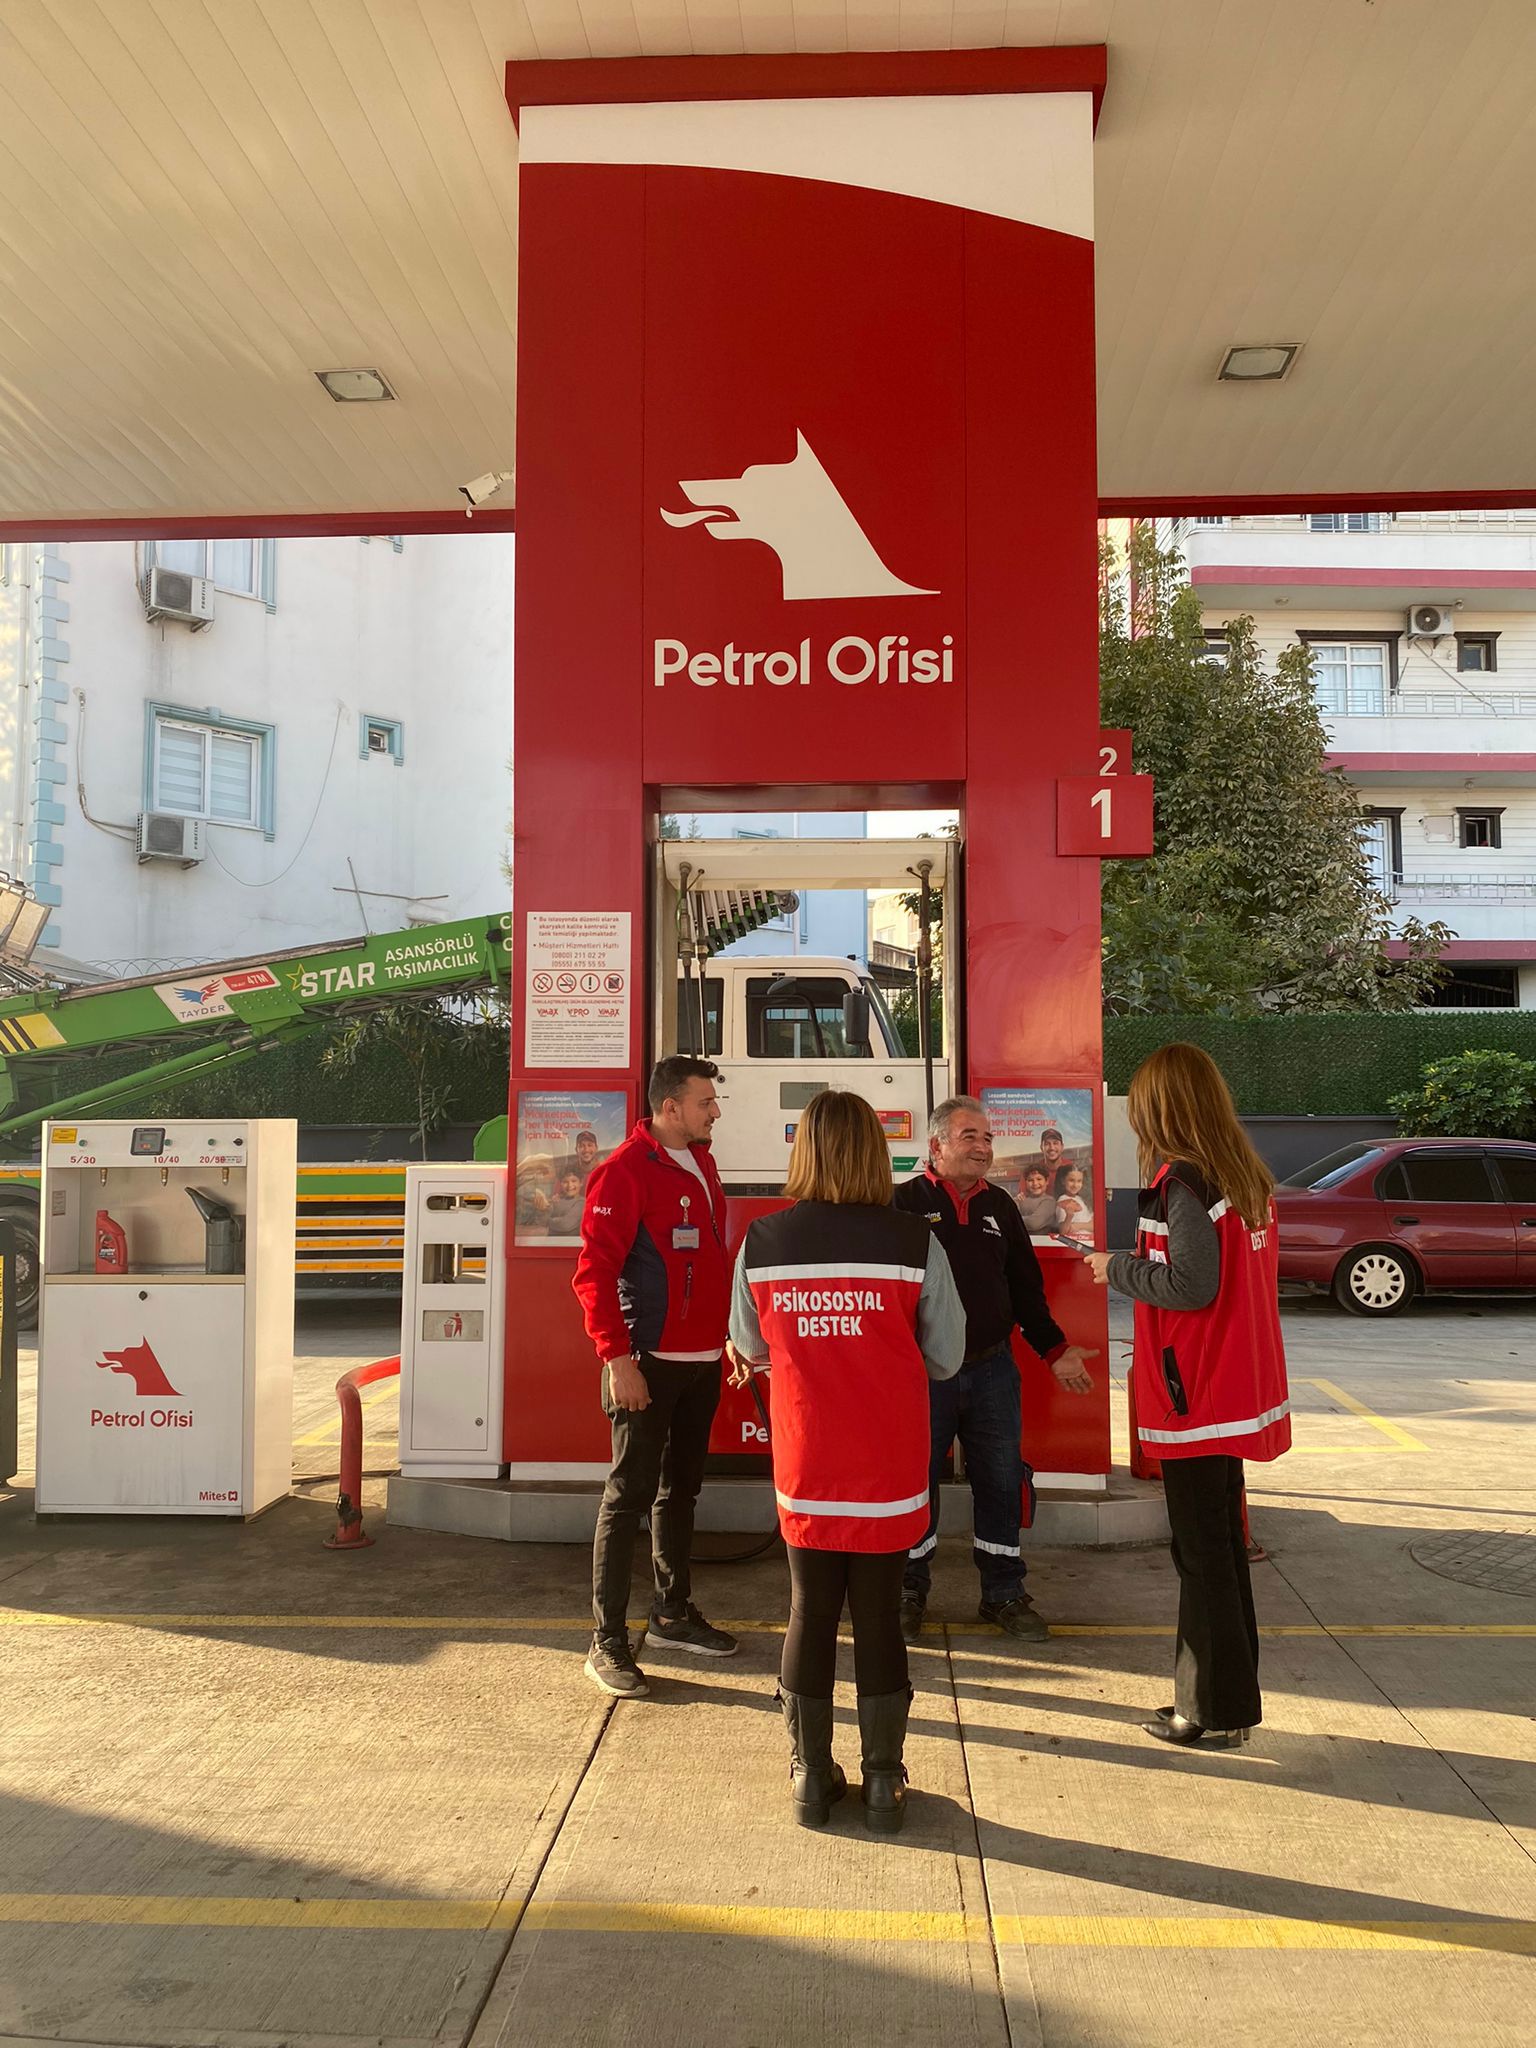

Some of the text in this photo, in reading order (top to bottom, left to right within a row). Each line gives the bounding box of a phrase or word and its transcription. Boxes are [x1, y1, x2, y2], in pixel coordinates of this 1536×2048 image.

[654, 635, 953, 687] Petrol Ofisi
[1099, 747, 1118, 776] 2
[1091, 788, 1111, 838] 1
[385, 932, 475, 963] ASANSÖRLÜ
[385, 951, 479, 979] TAŞIMACILIK
[247, 973, 269, 985] 47M
[301, 961, 375, 997] STAR
[180, 1004, 225, 1018] TAYDER
[70, 1156, 96, 1164] 5/30
[153, 1156, 179, 1164] 10/40
[772, 1286, 884, 1312] PSİKOSOSYAL
[797, 1315, 863, 1337] DESTEK
[90, 1409, 193, 1427] Petrol Ofisi
[199, 1491, 226, 1501] Mites
